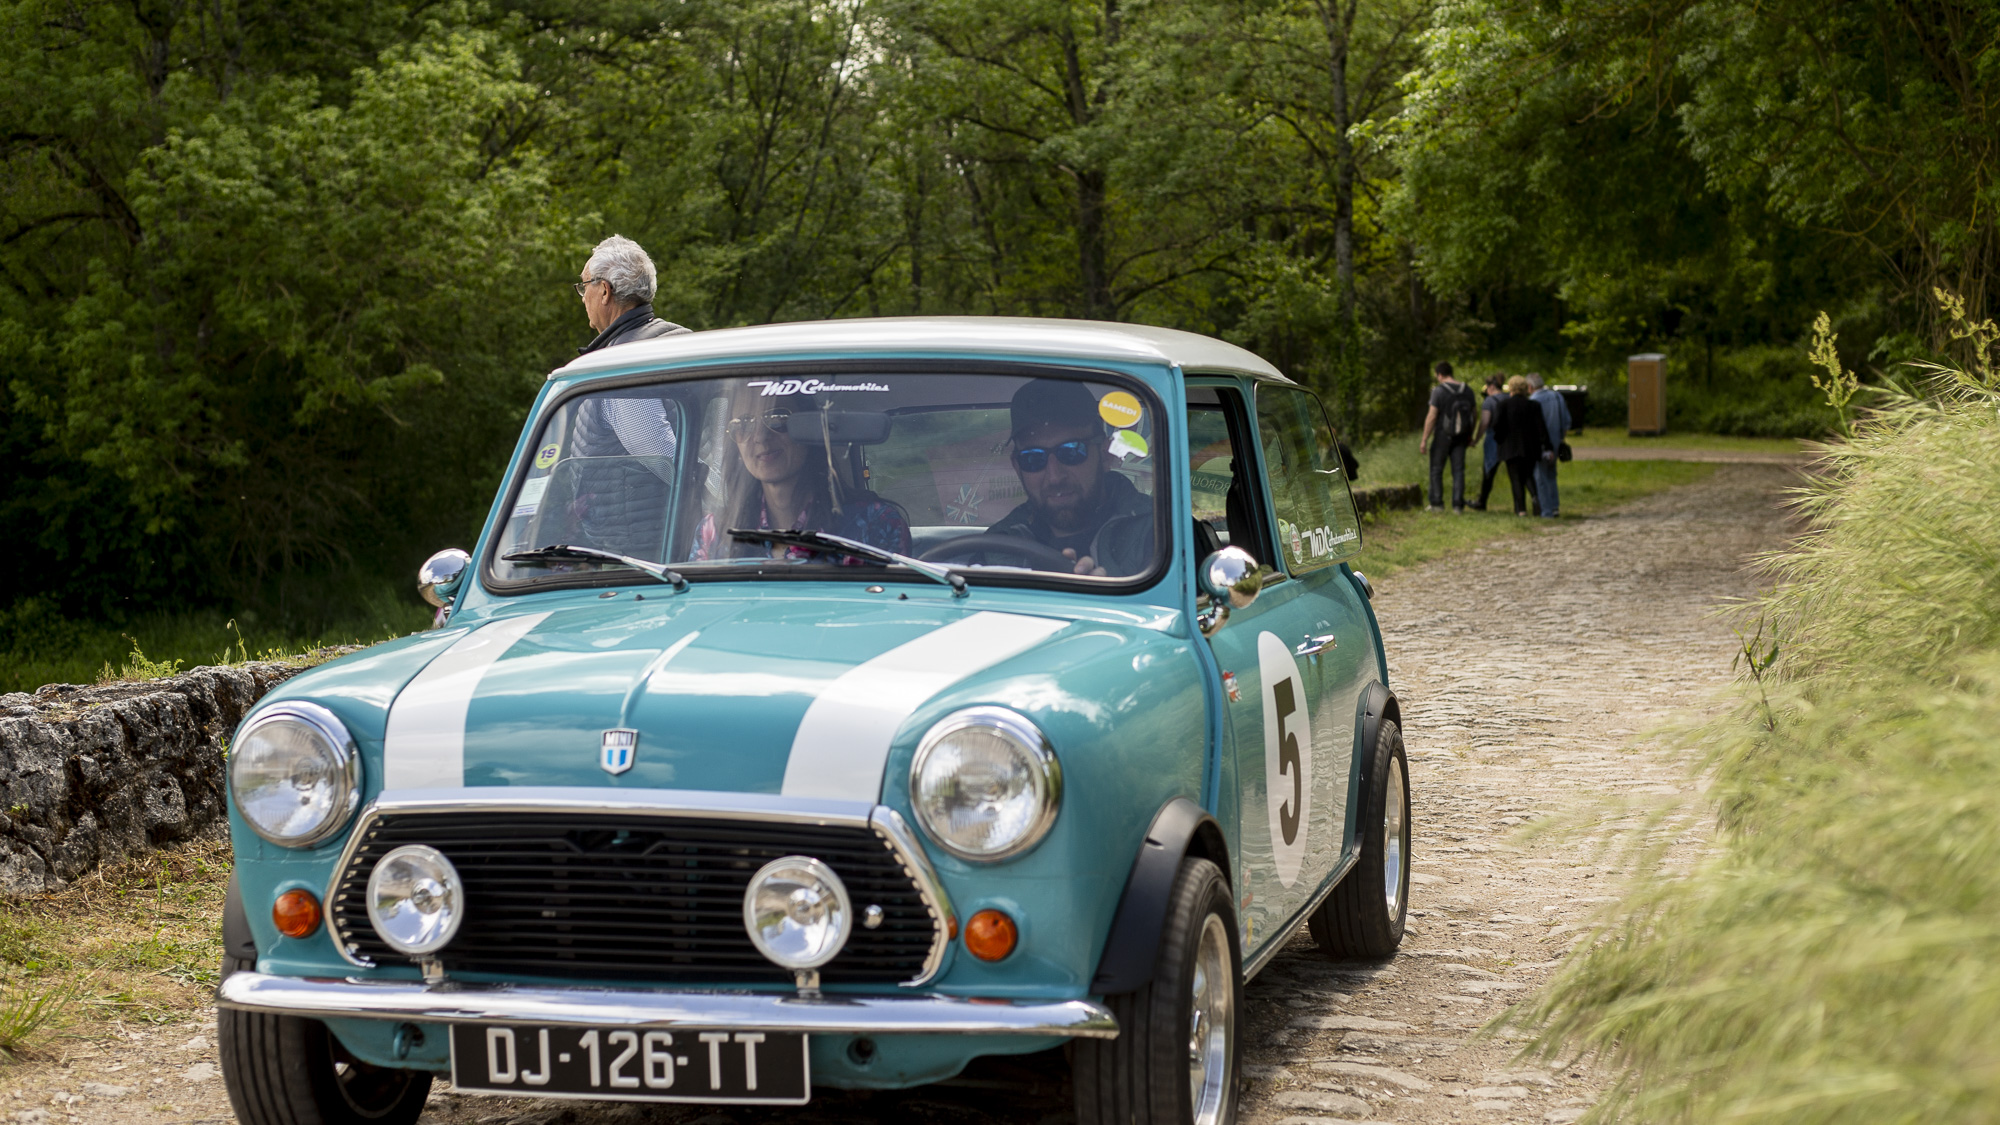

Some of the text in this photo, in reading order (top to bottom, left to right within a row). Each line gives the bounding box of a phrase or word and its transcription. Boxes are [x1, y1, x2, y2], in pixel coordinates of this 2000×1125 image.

[812, 382, 890, 392] Automobiles
[1102, 400, 1137, 416] SAMEDI
[541, 448, 556, 459] 19
[605, 732, 632, 746] MINI
[1273, 677, 1302, 846] 5
[486, 1027, 766, 1091] DJ-126-TT
